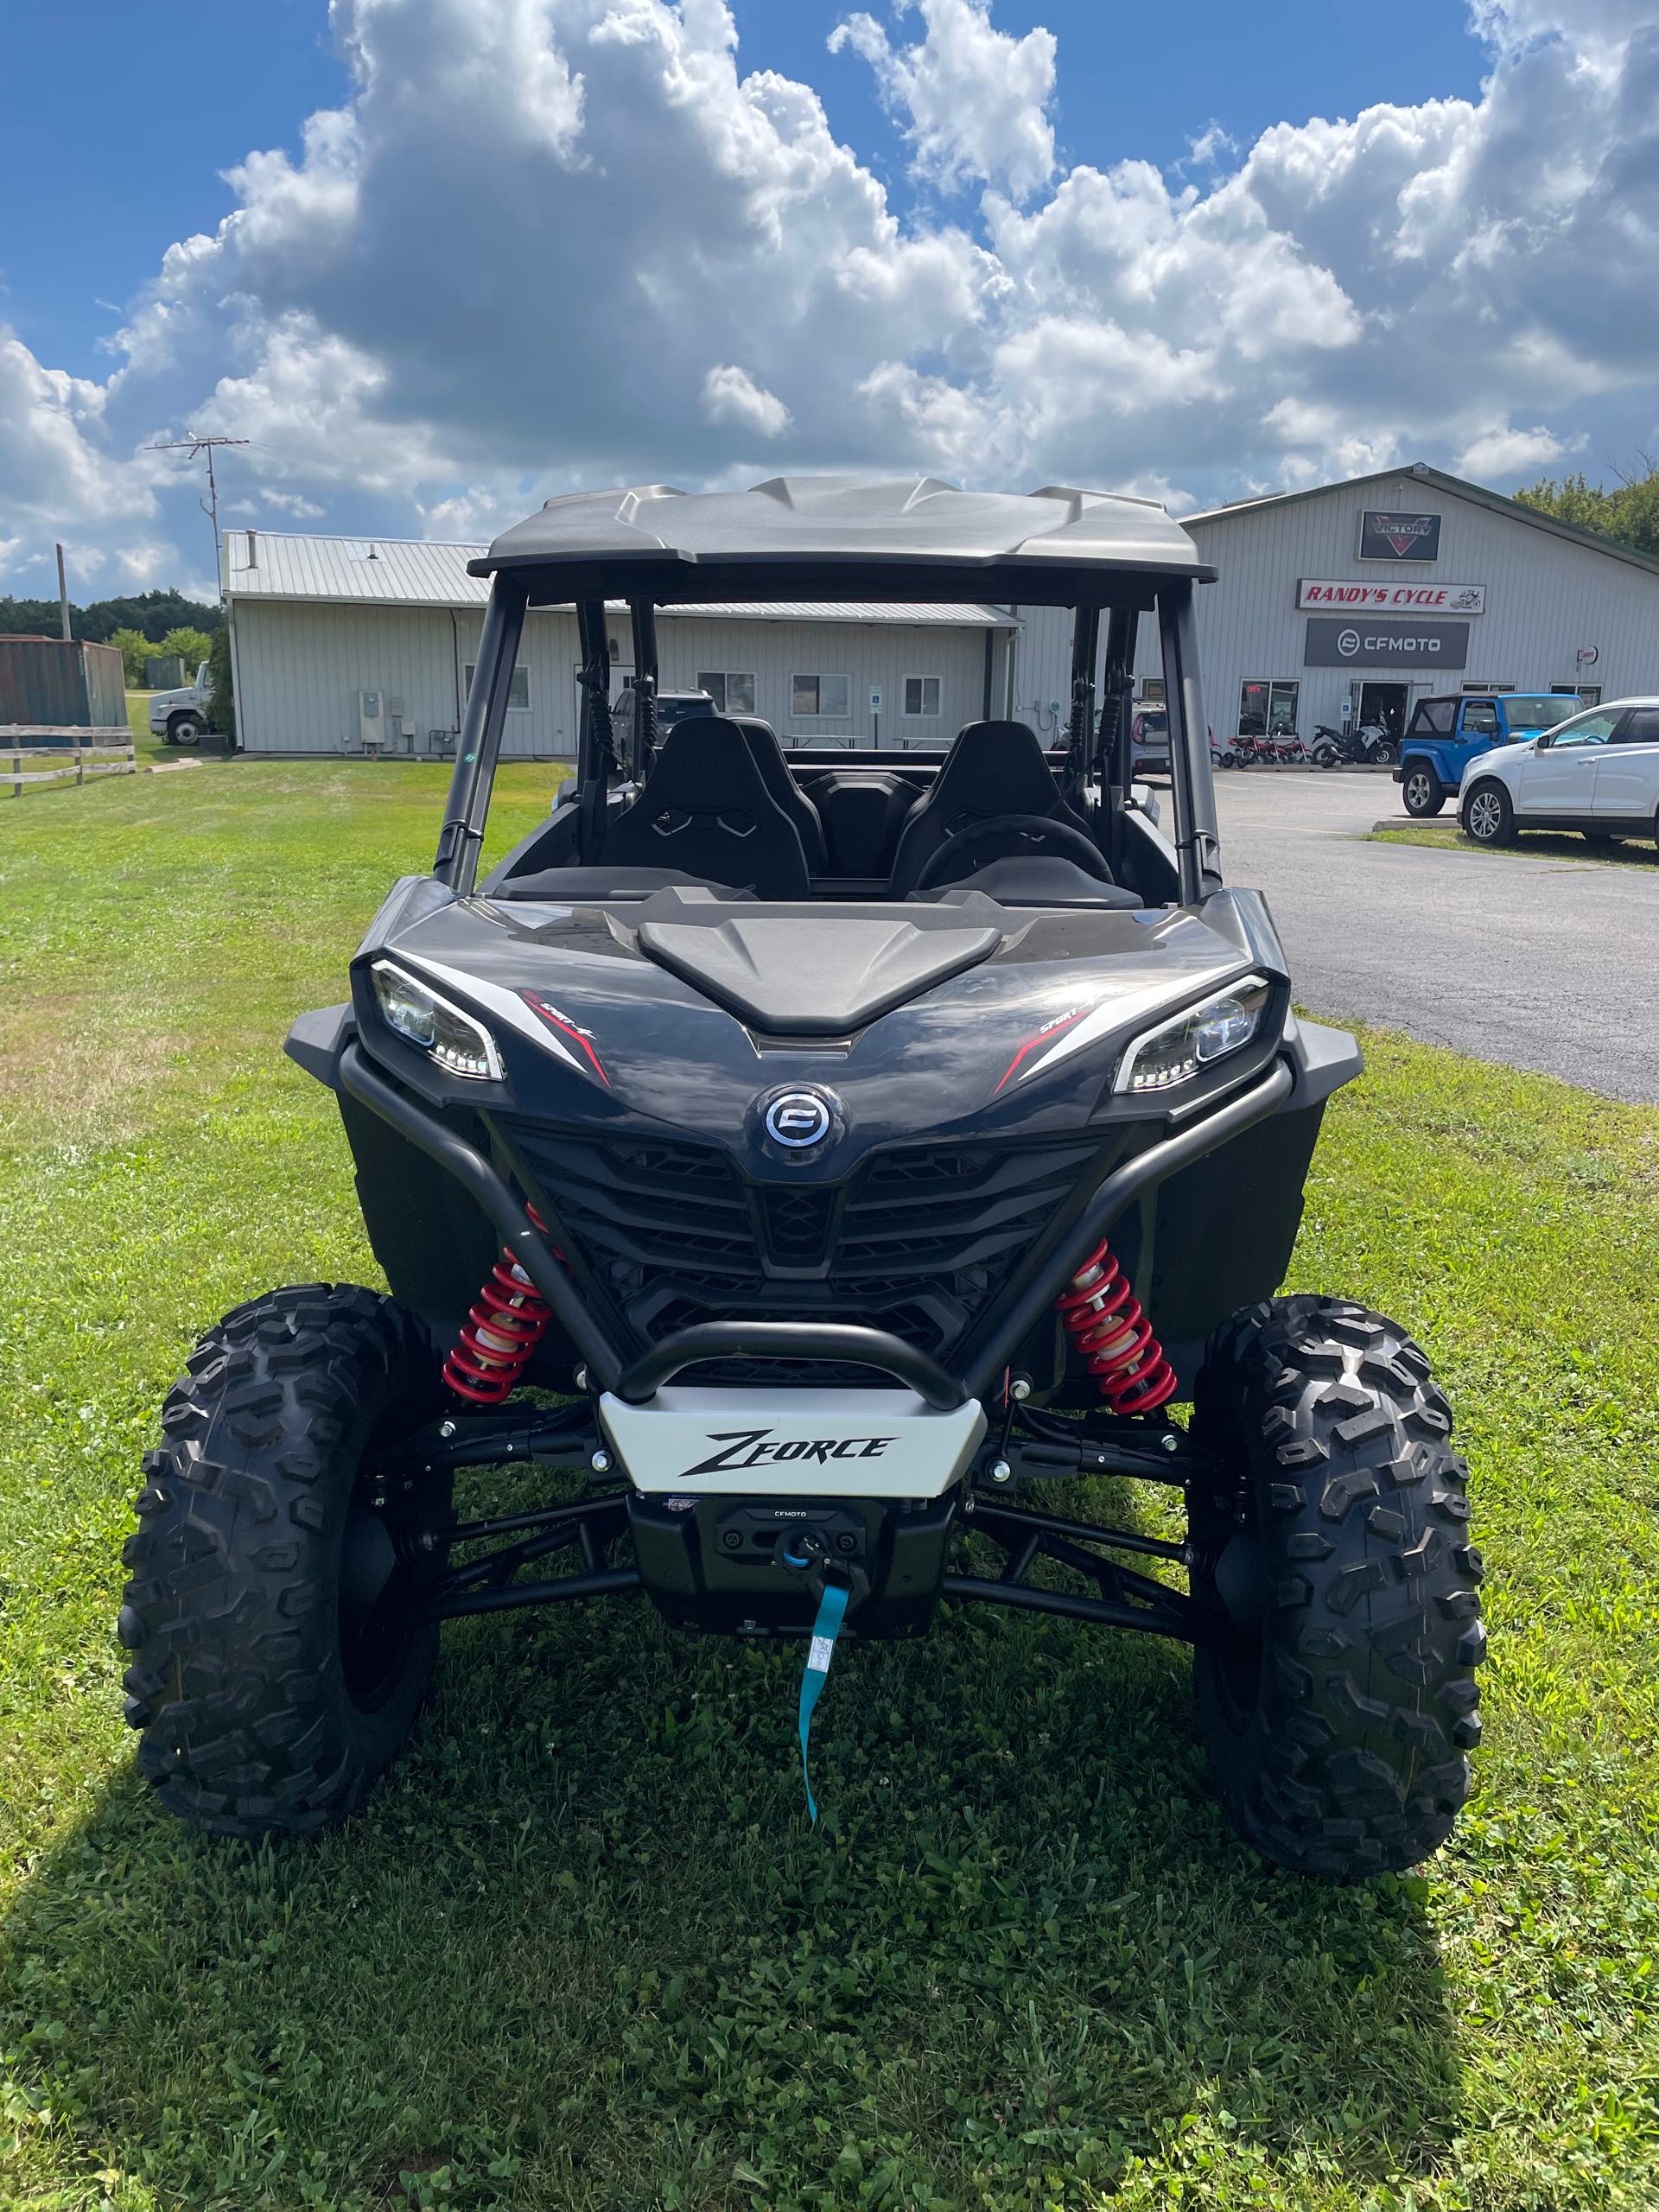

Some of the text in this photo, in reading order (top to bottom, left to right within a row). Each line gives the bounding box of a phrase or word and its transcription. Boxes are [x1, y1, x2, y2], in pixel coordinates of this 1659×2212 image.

[1375, 524, 1432, 534] VICTORY
[1306, 587, 1448, 605] RANDY'S CYCLE
[1363, 637, 1441, 652] CFMOTO
[1039, 1007, 1077, 1034] SPORT
[677, 1428, 901, 1477] ZFORCE
